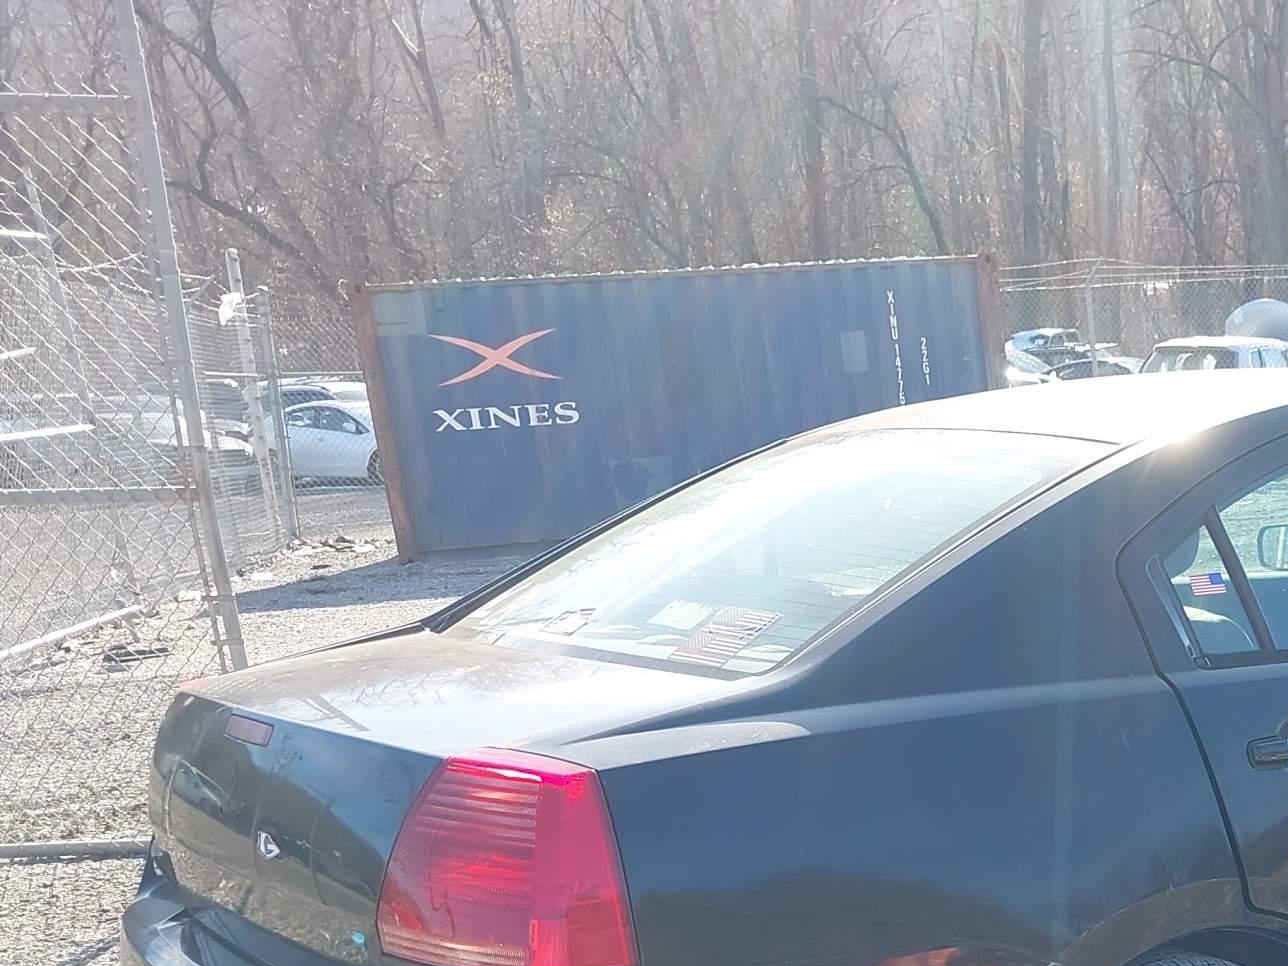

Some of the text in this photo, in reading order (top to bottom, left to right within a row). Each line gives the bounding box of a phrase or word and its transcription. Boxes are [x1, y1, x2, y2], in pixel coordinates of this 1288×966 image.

[886, 290, 899, 340] XINU
[920, 337, 930, 386] 22G1
[432, 401, 580, 432] XINES
